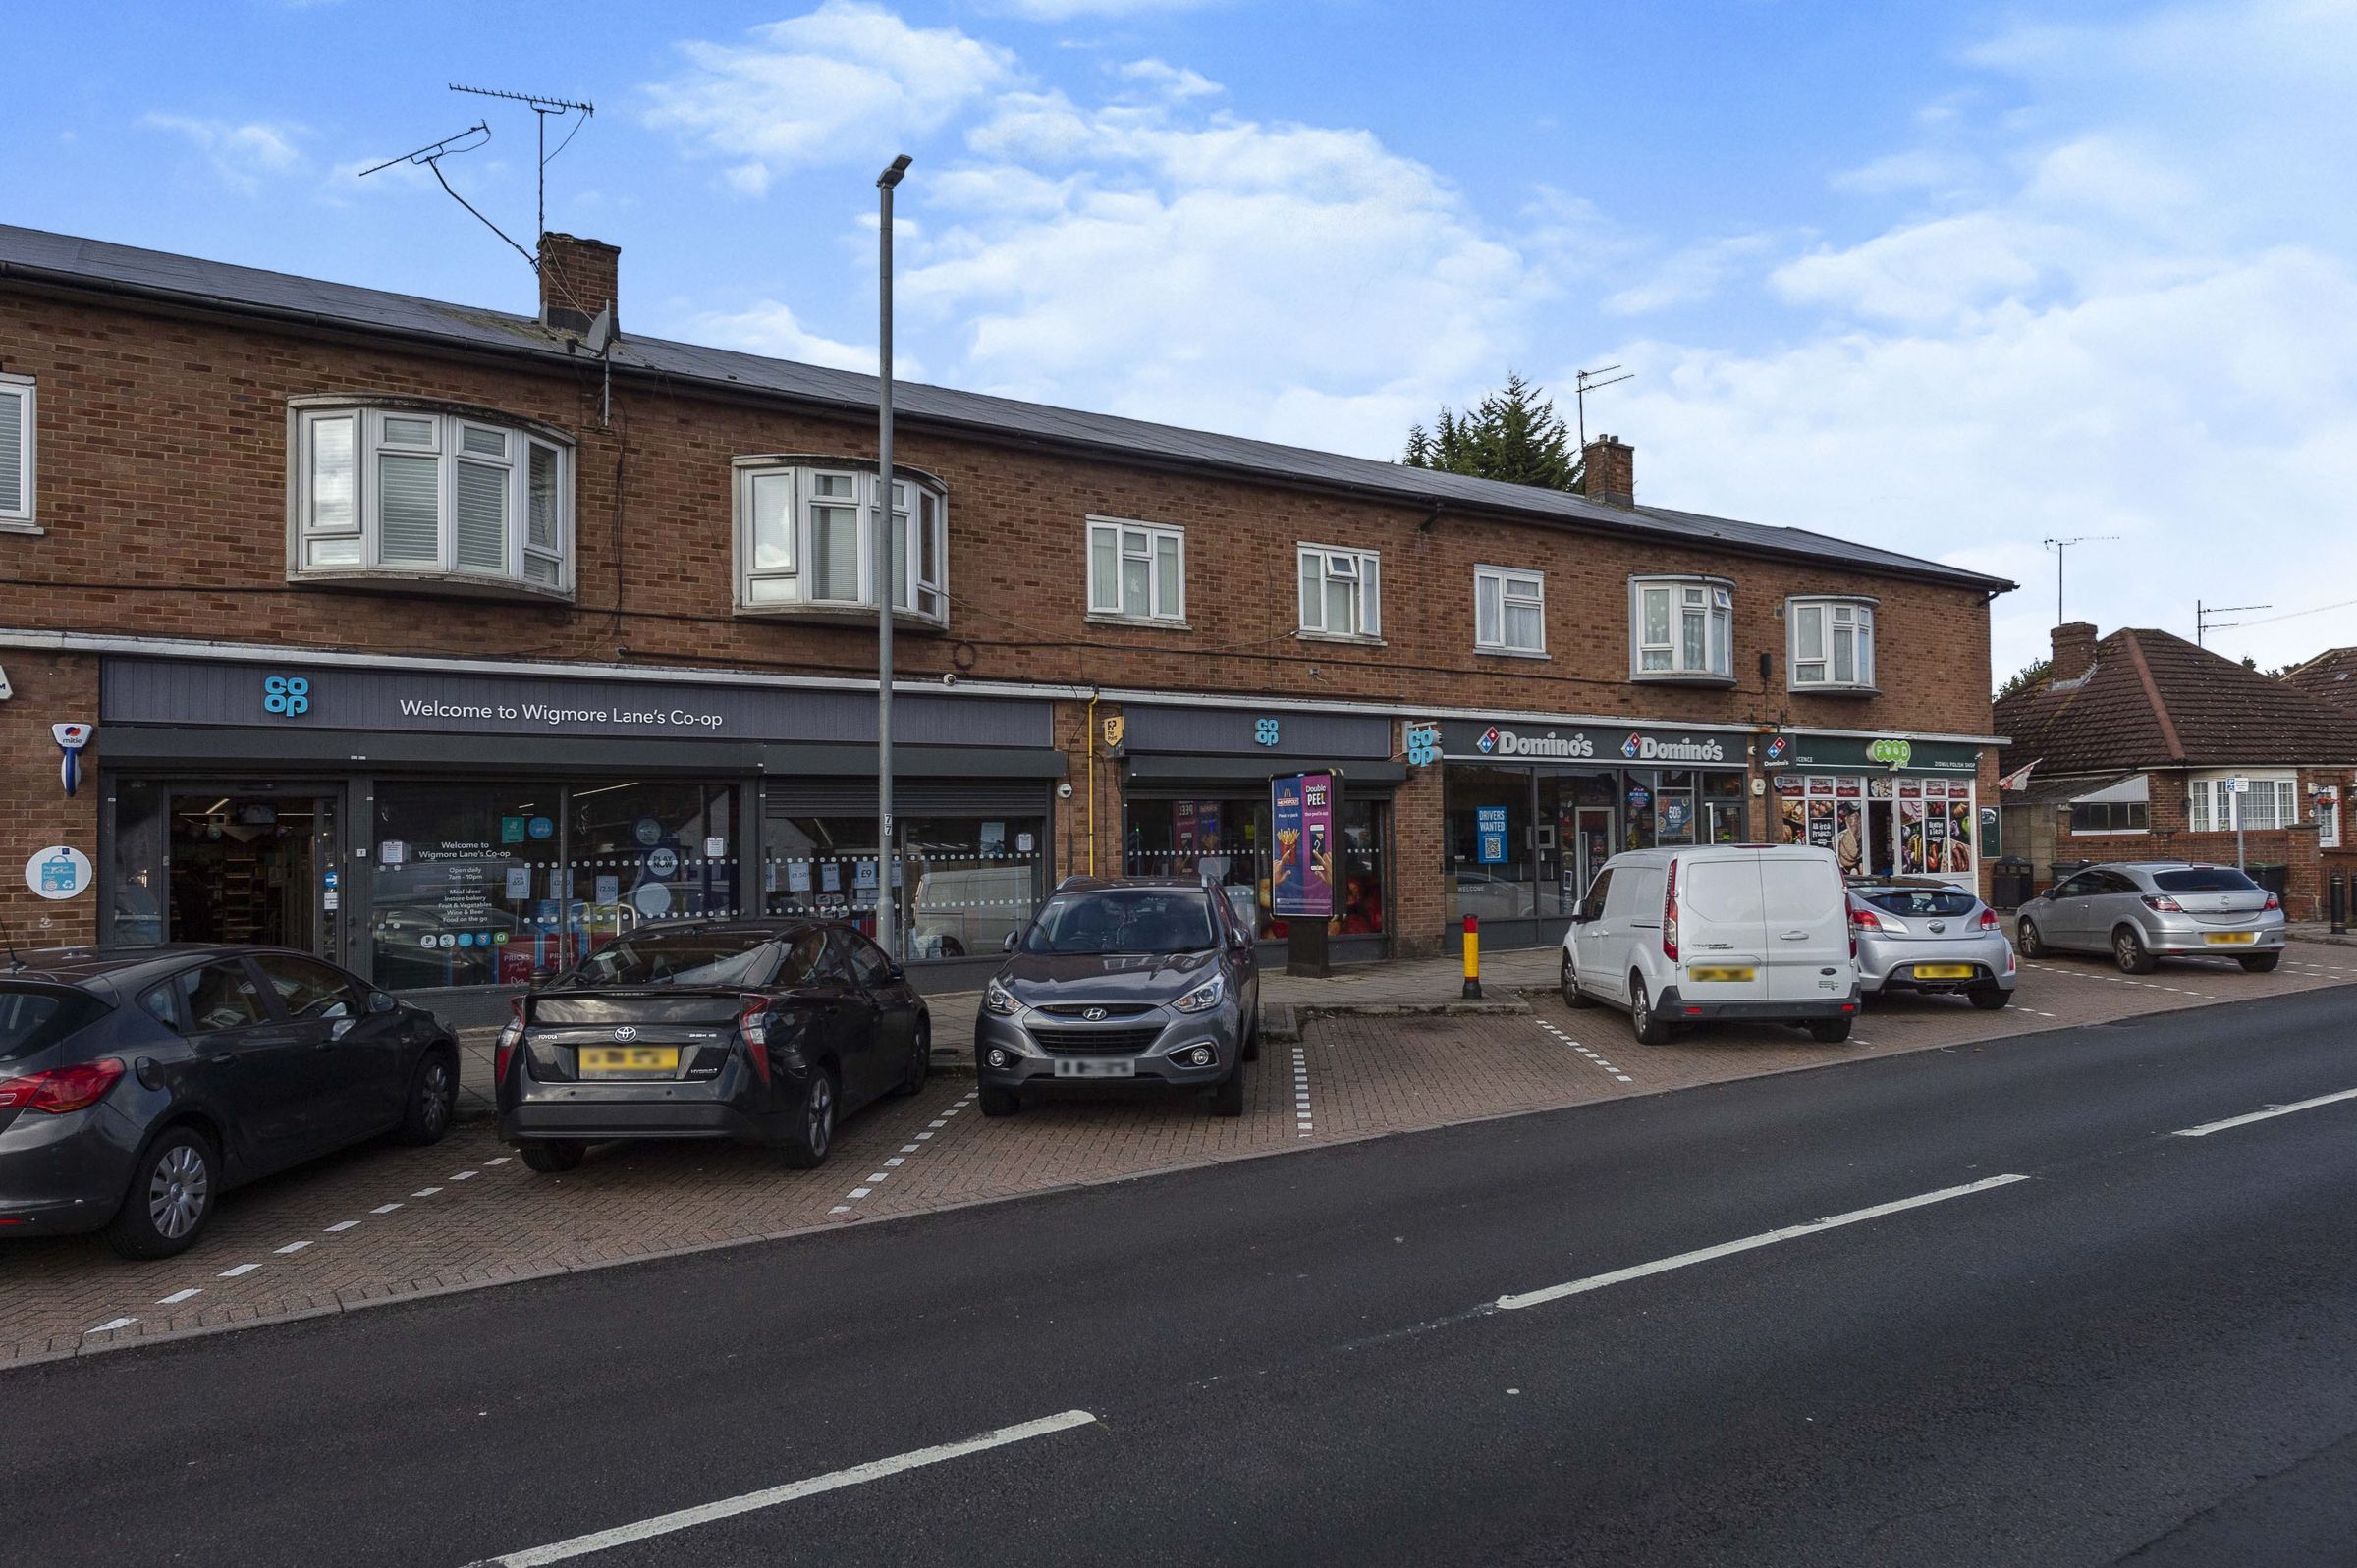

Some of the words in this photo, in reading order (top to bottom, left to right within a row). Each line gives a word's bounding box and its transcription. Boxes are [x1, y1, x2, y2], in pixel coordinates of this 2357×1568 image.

[400, 699, 492, 719] Welcome
[498, 705, 518, 719] to
[521, 704, 607, 725] Wigmore
[613, 707, 666, 724] Lane's
[670, 710, 723, 730] Co-op
[1498, 731, 1594, 757] Domino's
[1639, 737, 1724, 761] Domino's
[1876, 746, 1909, 757] FOOD
[1305, 784, 1327, 793] Double
[1307, 793, 1326, 806] PEEL
[885, 814, 892, 824] 7
[1479, 810, 1505, 821] DRIVERS
[885, 825, 892, 835] 7
[1479, 821, 1506, 832] WANTED
[418, 851, 458, 860] Wigmore
[485, 850, 511, 860] Co-op
[860, 870, 873, 879] £9
